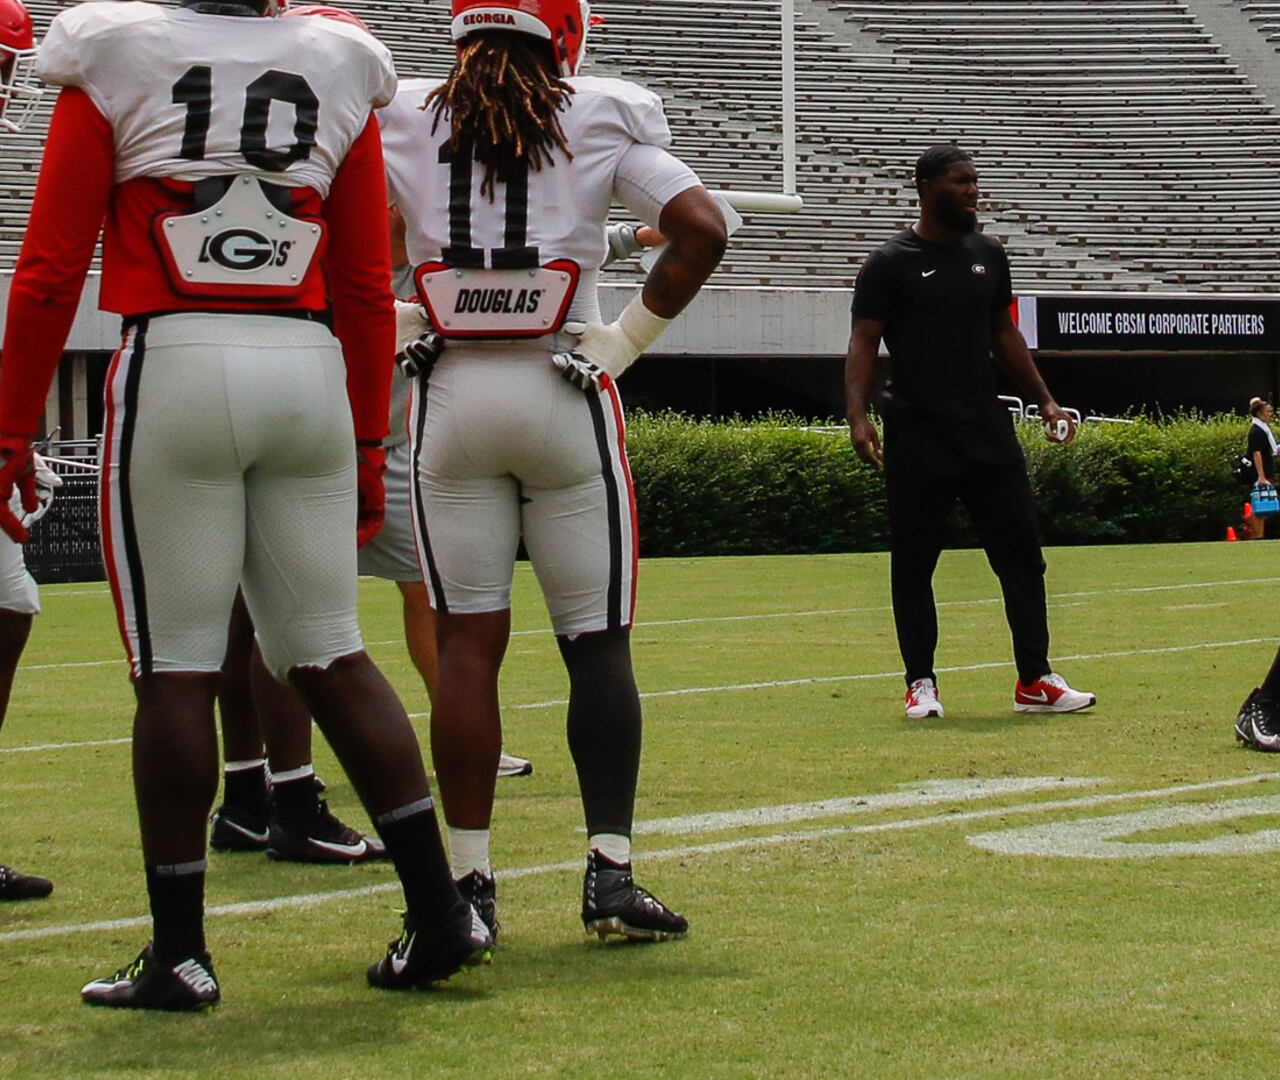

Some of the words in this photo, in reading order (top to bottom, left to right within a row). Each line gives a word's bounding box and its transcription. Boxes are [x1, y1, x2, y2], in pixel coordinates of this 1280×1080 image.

[463, 13, 516, 26] GEORGIA
[172, 65, 320, 173] 10
[454, 288, 542, 314] DOUGLAS
[1058, 312, 1112, 334] WELCOME
[1115, 312, 1146, 334] GBSM
[1149, 313, 1209, 334] CORPORATE
[1212, 314, 1265, 335] PARTNERS
